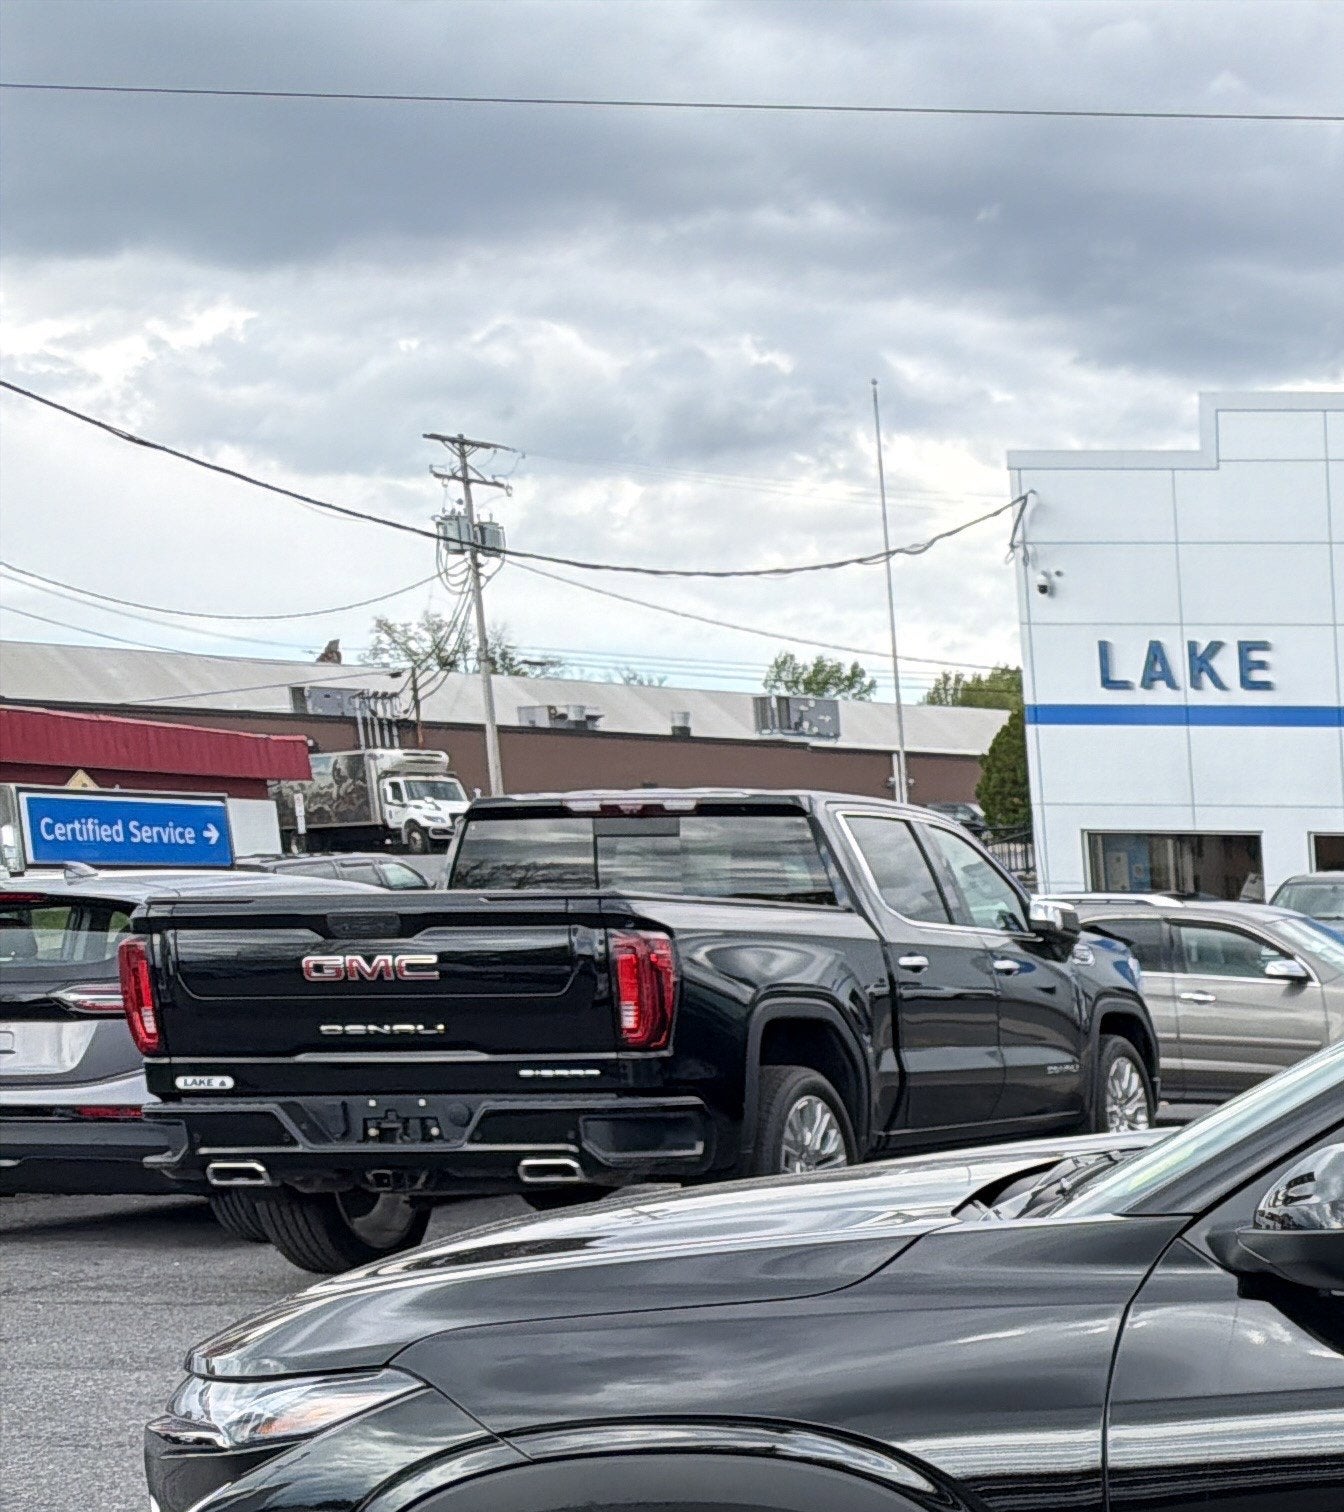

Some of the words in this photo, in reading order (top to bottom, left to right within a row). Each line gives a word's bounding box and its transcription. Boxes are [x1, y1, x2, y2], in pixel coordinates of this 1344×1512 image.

[1097, 639, 1276, 692] LAKE
[39, 816, 124, 843] Certified
[128, 818, 196, 845] Service
[301, 954, 440, 982] GMC
[319, 1023, 445, 1035] DENALI
[183, 1078, 214, 1087] LAKE
